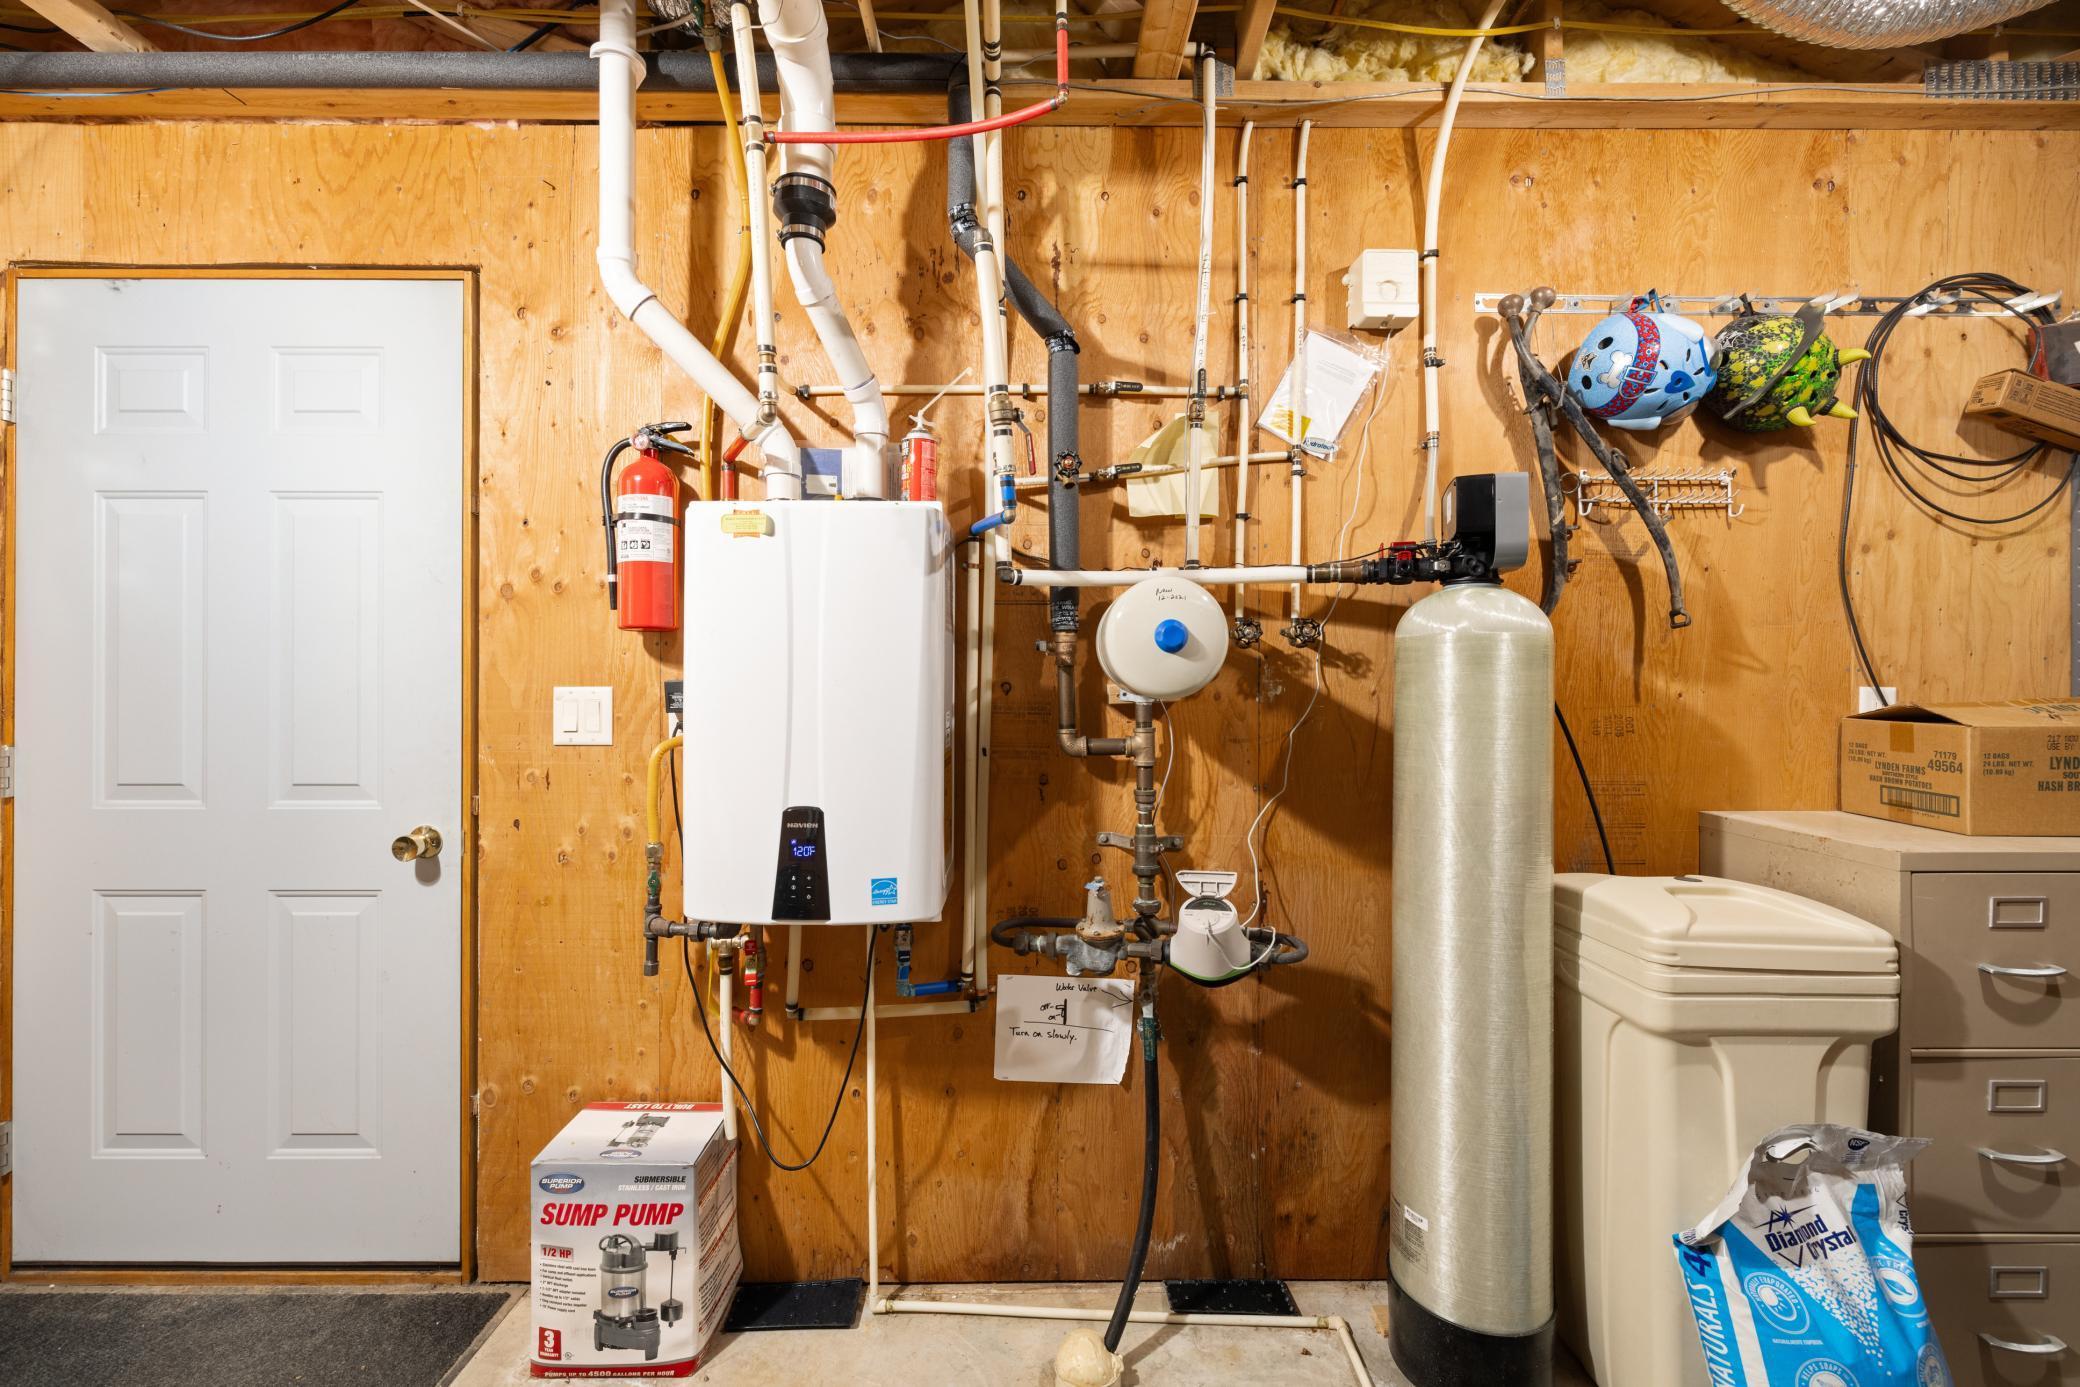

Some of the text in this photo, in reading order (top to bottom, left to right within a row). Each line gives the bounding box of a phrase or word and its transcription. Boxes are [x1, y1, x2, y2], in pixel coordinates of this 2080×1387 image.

[2047, 742, 2061, 750] USE
[1934, 750, 1957, 760] 71179
[1875, 760, 1926, 776] LYNDEN FARMS
[1927, 759, 1963, 774] 49564
[1904, 779, 1932, 790] POTATOES
[2038, 781, 2063, 791] HASH
[1078, 984, 1097, 992] Valve
[1009, 1026, 1029, 1037] Turn
[1048, 1029, 1078, 1045] slowly.
[634, 1175, 686, 1183] SUBMERSIBLE
[540, 1203, 684, 1226] SUMP PUMP
[1764, 1214, 1829, 1252] Diamond
[1806, 1225, 1857, 1260] Crystal
[543, 1247, 572, 1259] 1/2 HP
[544, 1330, 555, 1348] 3
[1802, 1362, 1819, 1380] HELPS
